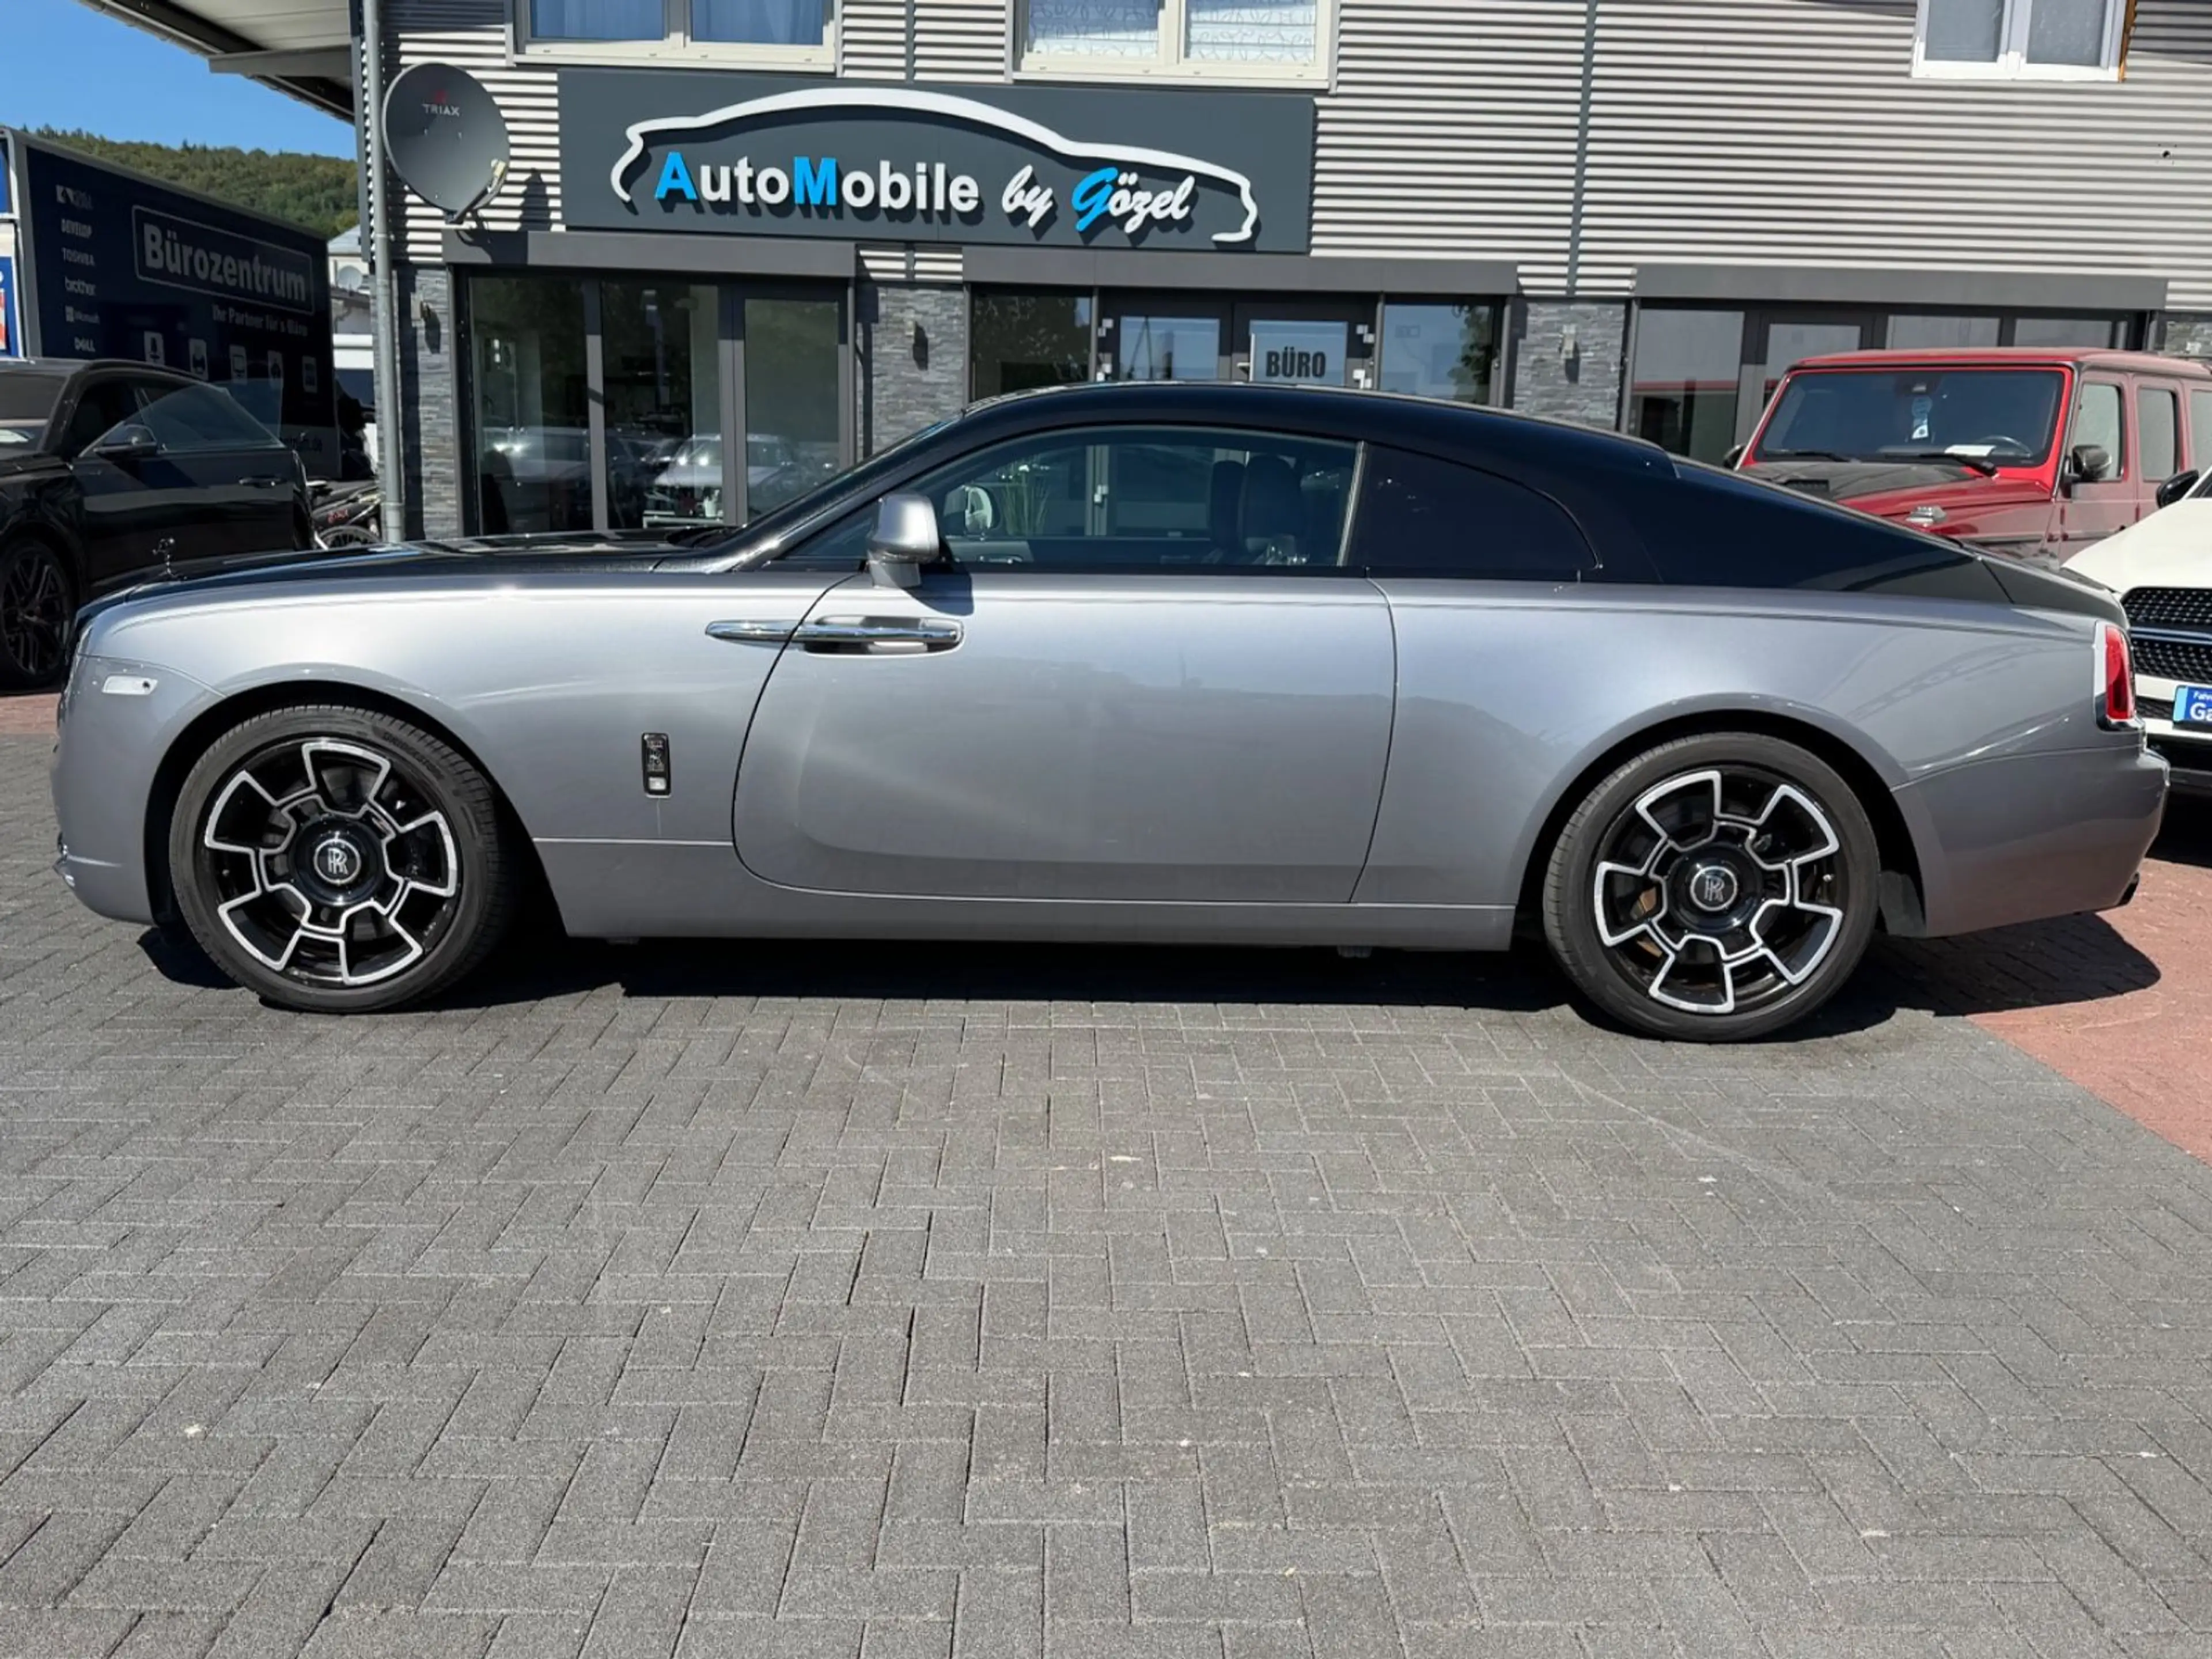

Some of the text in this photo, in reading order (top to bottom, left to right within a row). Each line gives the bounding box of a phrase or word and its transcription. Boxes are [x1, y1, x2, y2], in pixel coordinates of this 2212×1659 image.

[422, 104, 460, 118] TRIAX
[656, 151, 1196, 232] AutoMobile by Gözel
[143, 223, 306, 302] Bürozentrum
[1266, 346, 1326, 378] BÜRO
